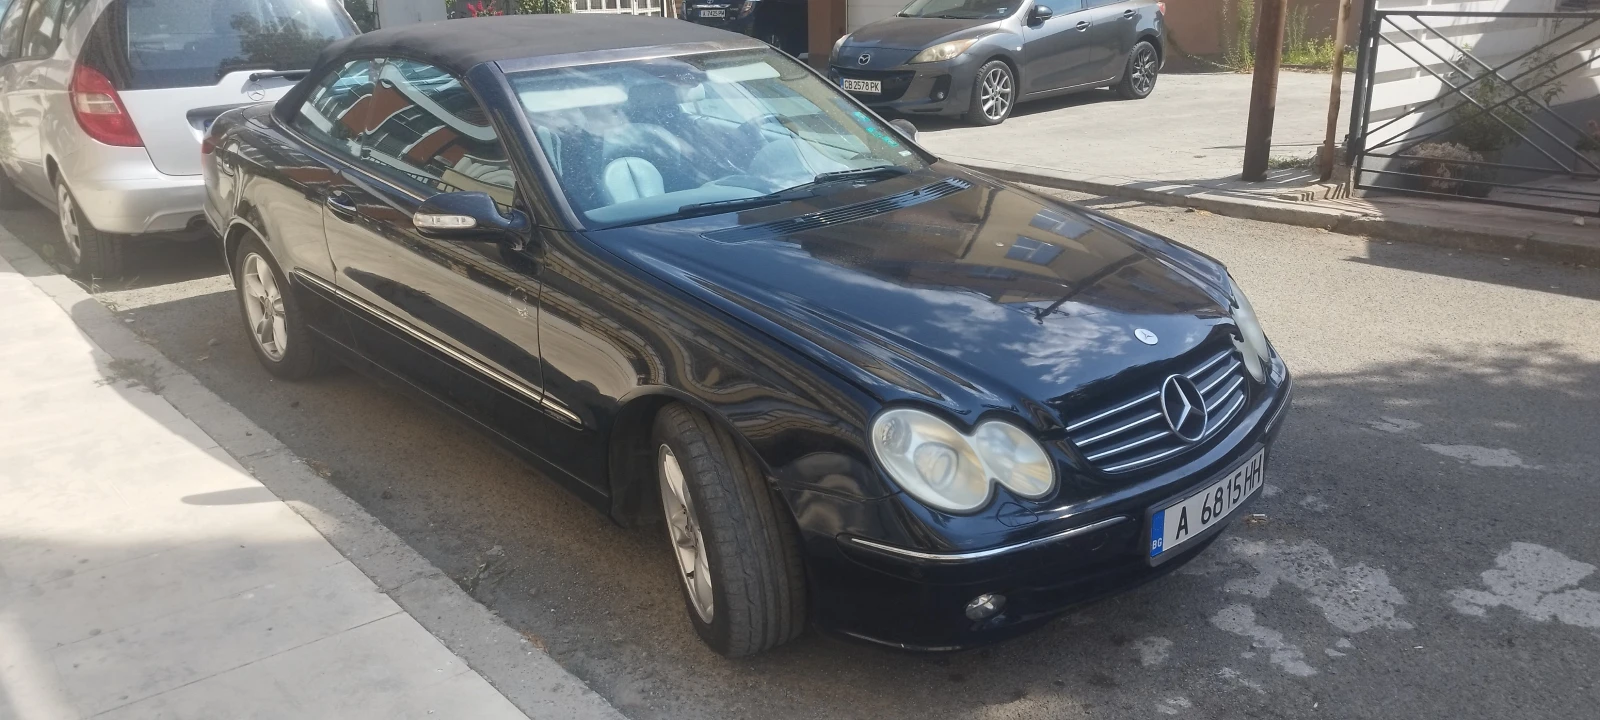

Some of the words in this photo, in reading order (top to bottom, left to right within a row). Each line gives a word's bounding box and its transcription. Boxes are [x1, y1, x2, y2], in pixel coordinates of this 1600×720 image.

[844, 80, 853, 90] CB
[853, 80, 869, 91] 2578
[870, 82, 880, 92] PK
[1175, 505, 1189, 541] A
[1152, 538, 1163, 550] BG
